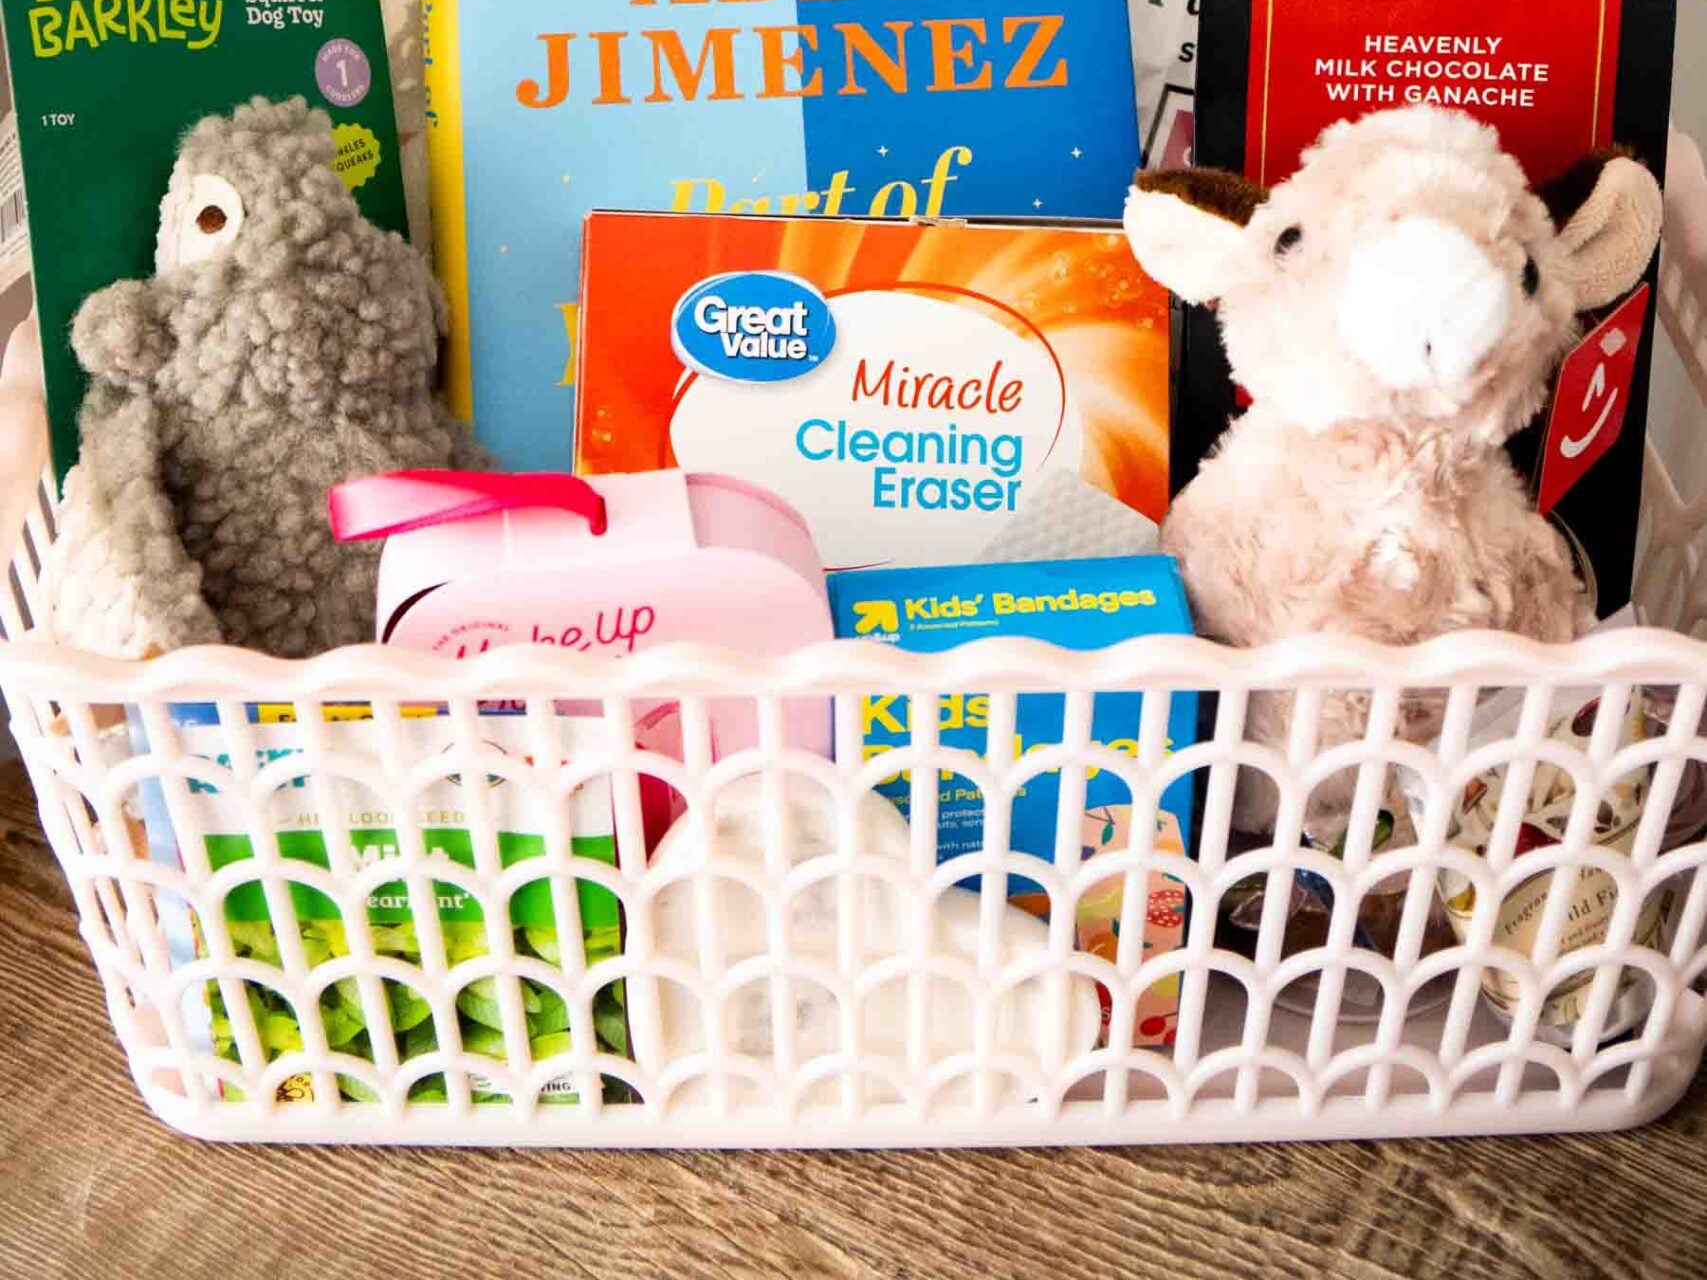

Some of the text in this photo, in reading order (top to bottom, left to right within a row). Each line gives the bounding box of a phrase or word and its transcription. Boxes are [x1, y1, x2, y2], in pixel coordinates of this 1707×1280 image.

[245, 5, 324, 30] Dog Toy
[1364, 34, 1503, 55] HEAVENLY
[336, 59, 348, 87] 1
[516, 14, 1069, 109] JIMENEZ
[1314, 58, 1550, 82] MILK CHOCOLATE
[1325, 83, 1535, 108] WITH GANACHE
[41, 113, 76, 127] 1 TOY
[334, 149, 374, 172] QUEAKS
[869, 145, 973, 217] of
[693, 294, 809, 338] Great
[720, 331, 808, 362] Value
[851, 358, 1024, 414] Miracle
[795, 418, 1024, 478] Cleaning
[873, 467, 1023, 512] Eraser
[904, 588, 1156, 620] Kids' Bandages
[861, 694, 990, 735] Kds
